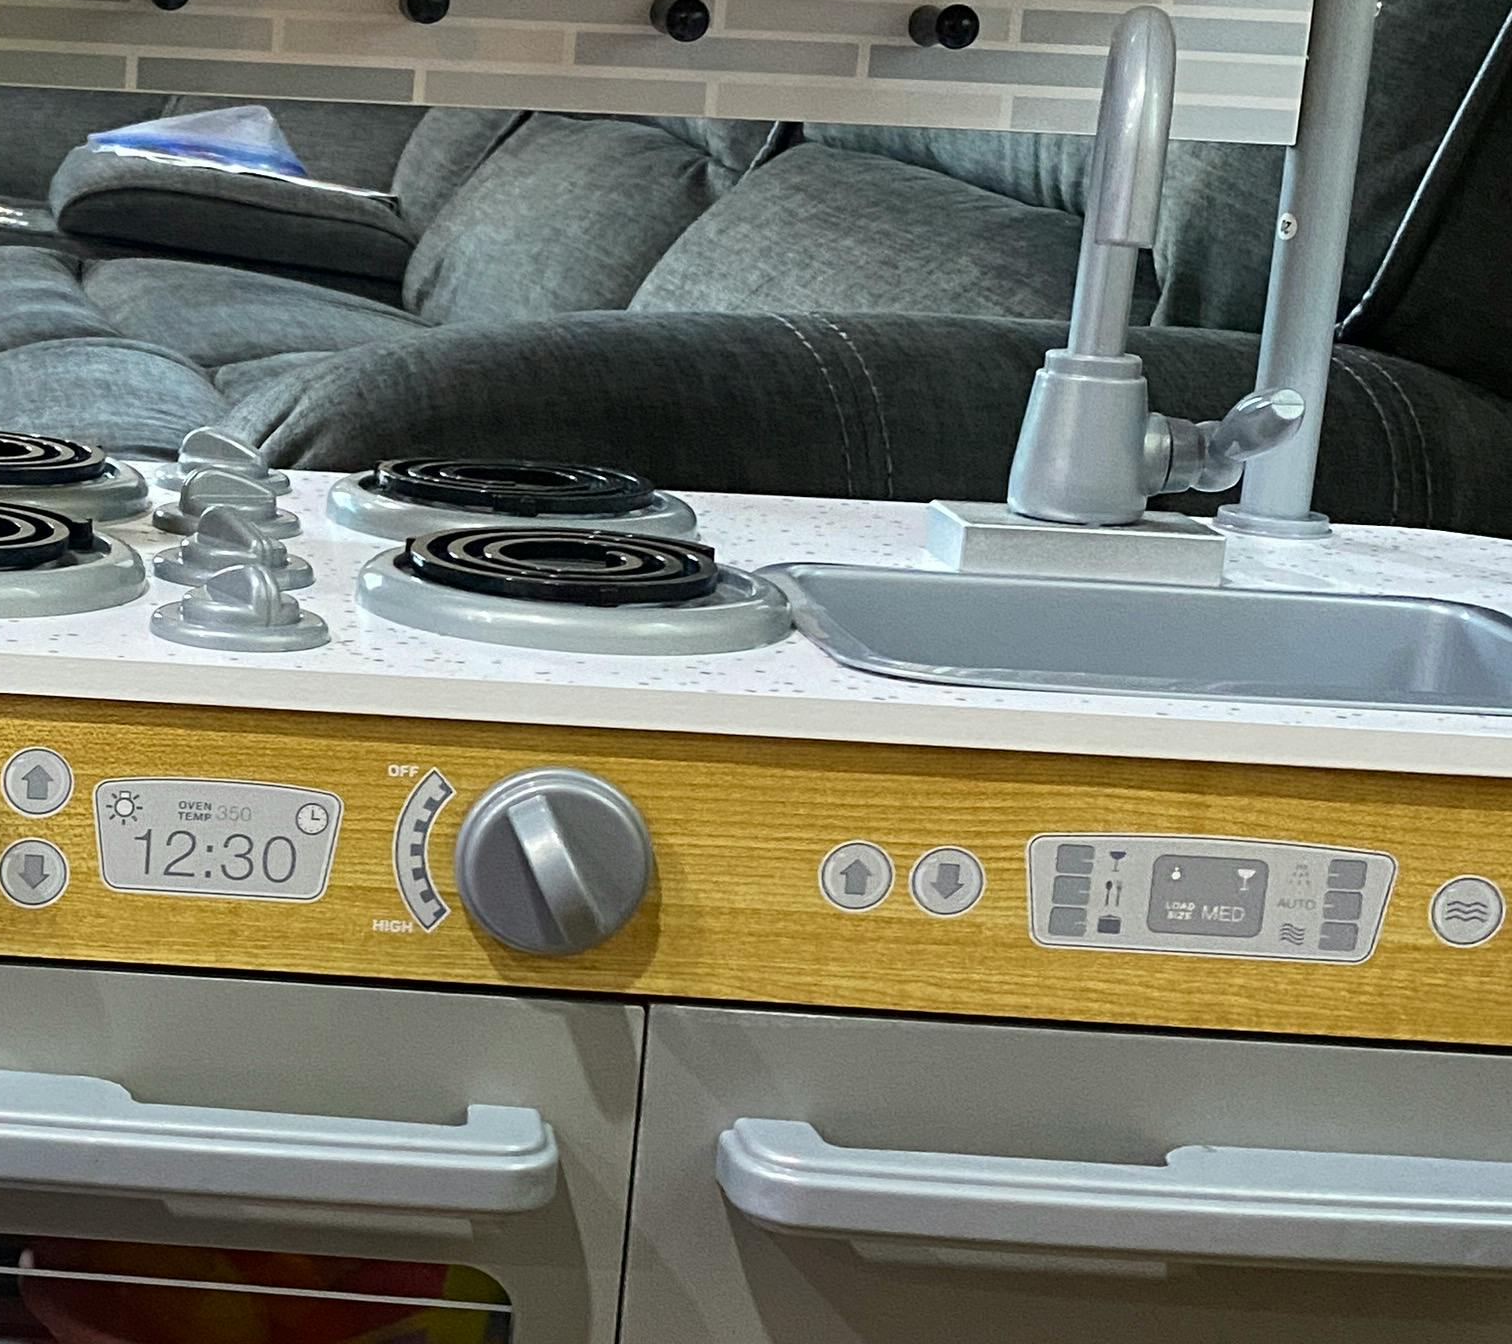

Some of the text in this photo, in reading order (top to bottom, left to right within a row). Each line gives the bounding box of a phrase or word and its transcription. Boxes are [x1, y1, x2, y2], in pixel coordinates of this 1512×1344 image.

[388, 764, 420, 777] OFF
[178, 800, 212, 811] OVEN
[178, 811, 212, 821] TEMP
[216, 805, 252, 822] 350
[133, 828, 297, 884] 12:30
[1277, 899, 1317, 911] AUTO
[1201, 904, 1246, 923] MED
[372, 919, 414, 933] HIGH
